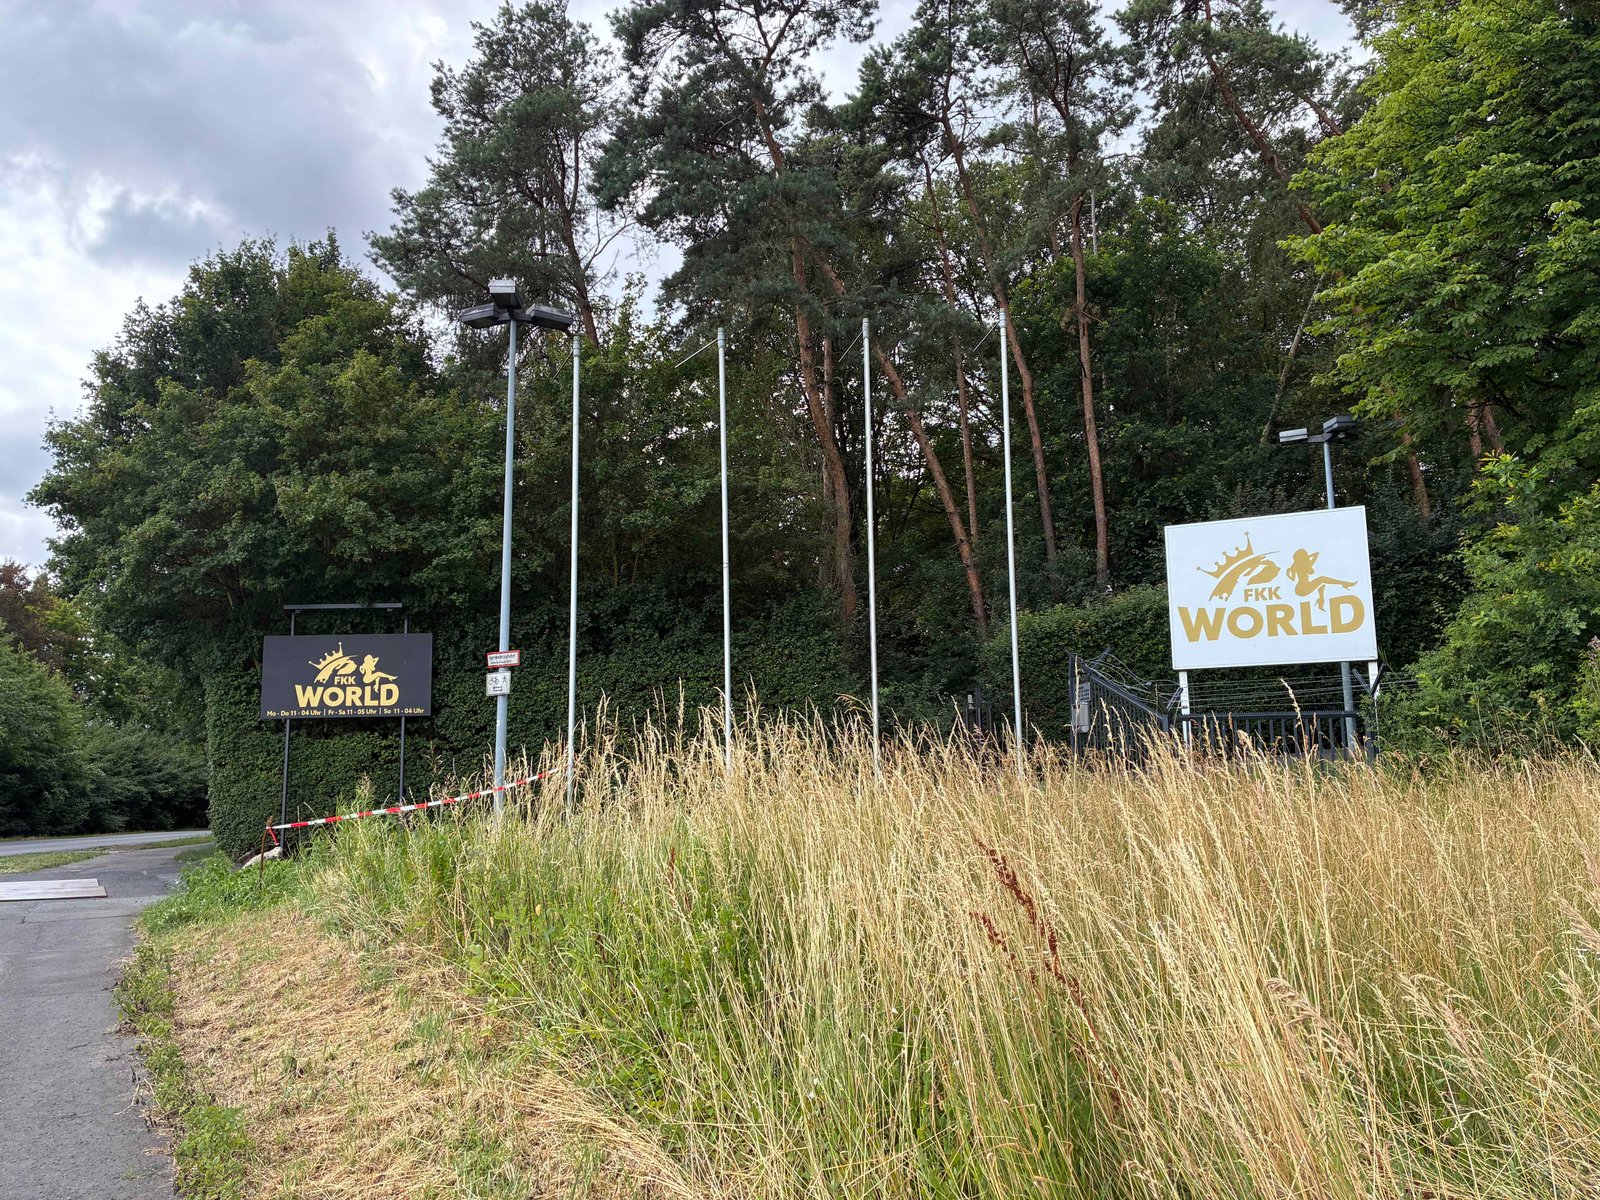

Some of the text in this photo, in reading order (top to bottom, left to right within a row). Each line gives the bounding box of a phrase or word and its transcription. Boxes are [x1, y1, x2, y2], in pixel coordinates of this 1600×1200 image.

[1243, 586, 1282, 603] FKK
[1177, 594, 1365, 643] WORLD
[334, 675, 356, 686] FKK
[295, 683, 400, 708] WORLD
